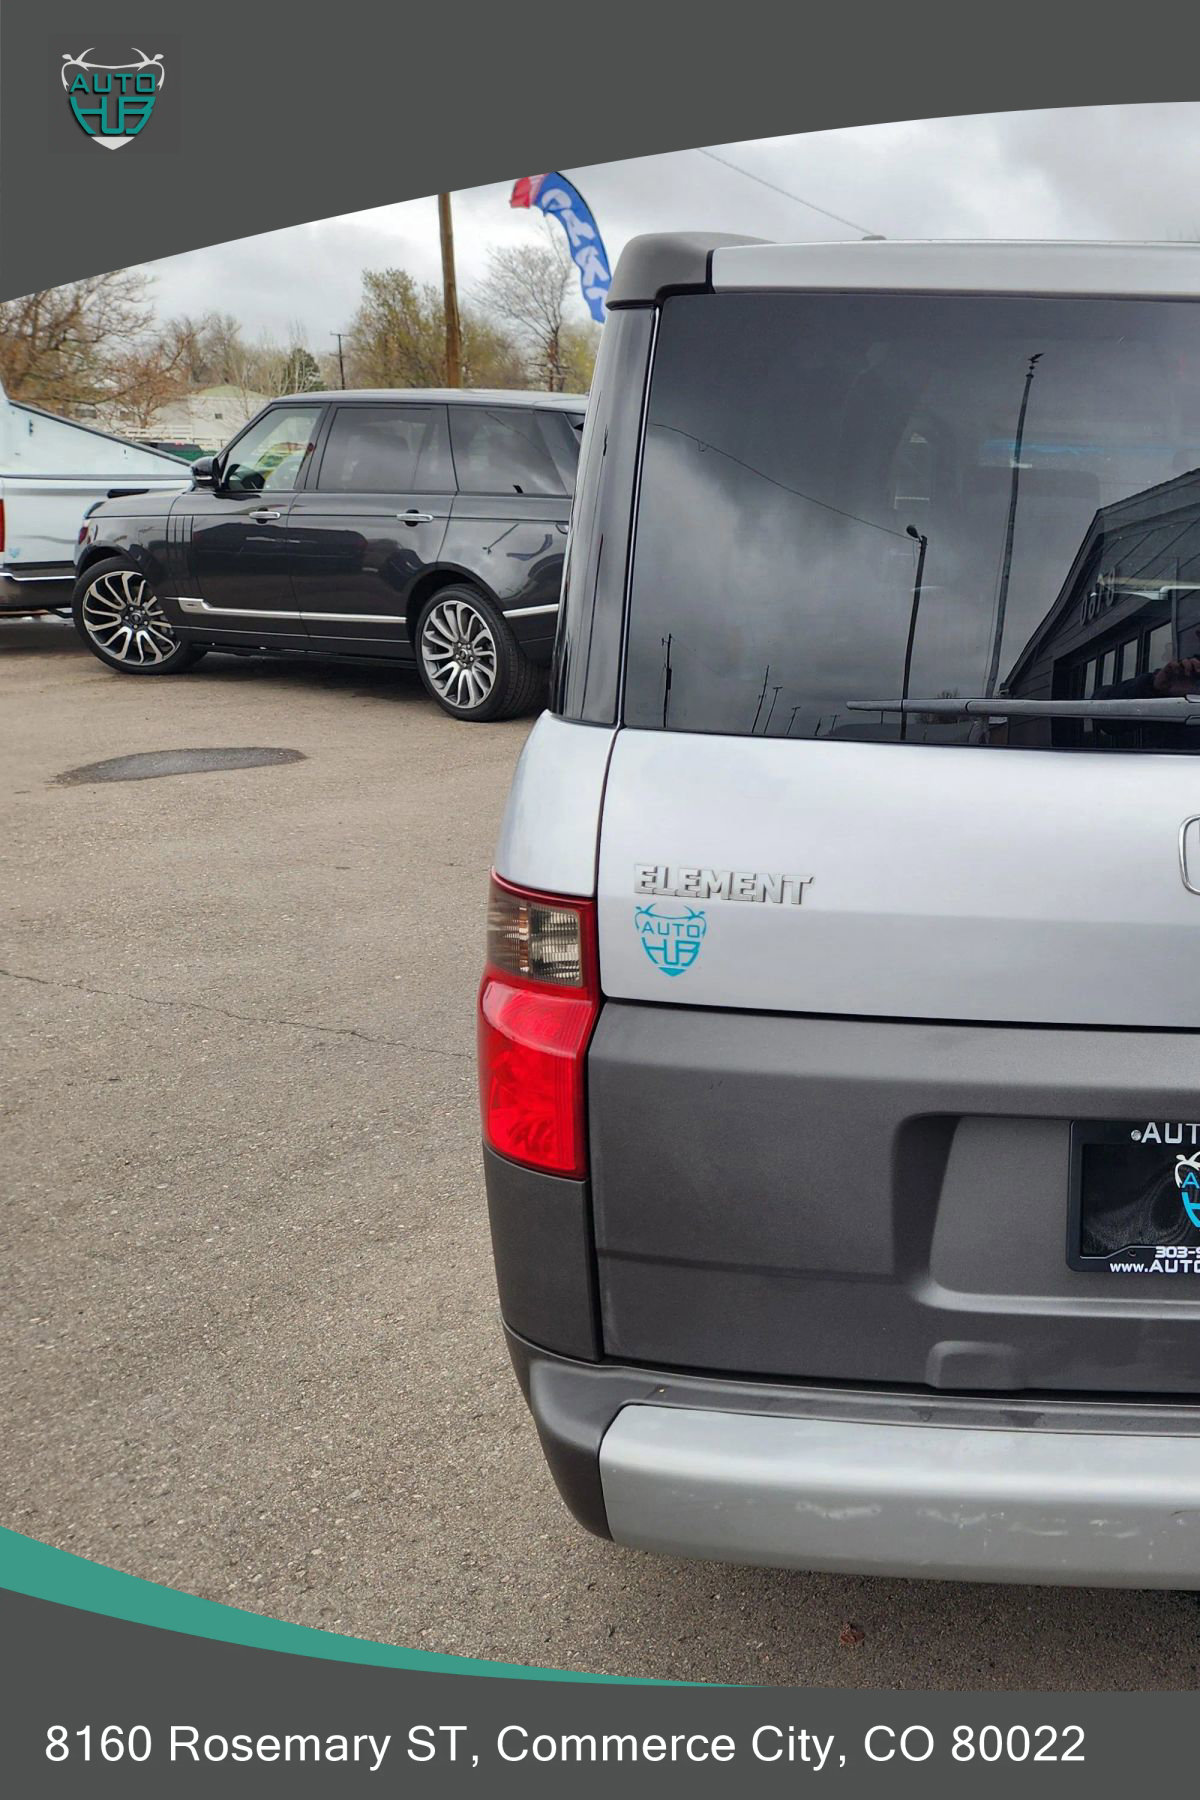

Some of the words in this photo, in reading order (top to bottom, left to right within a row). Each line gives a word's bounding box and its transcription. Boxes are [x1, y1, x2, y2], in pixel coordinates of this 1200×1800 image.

[634, 864, 814, 905] ELEMENT
[641, 920, 700, 938] AUTO
[641, 937, 701, 967] HUB
